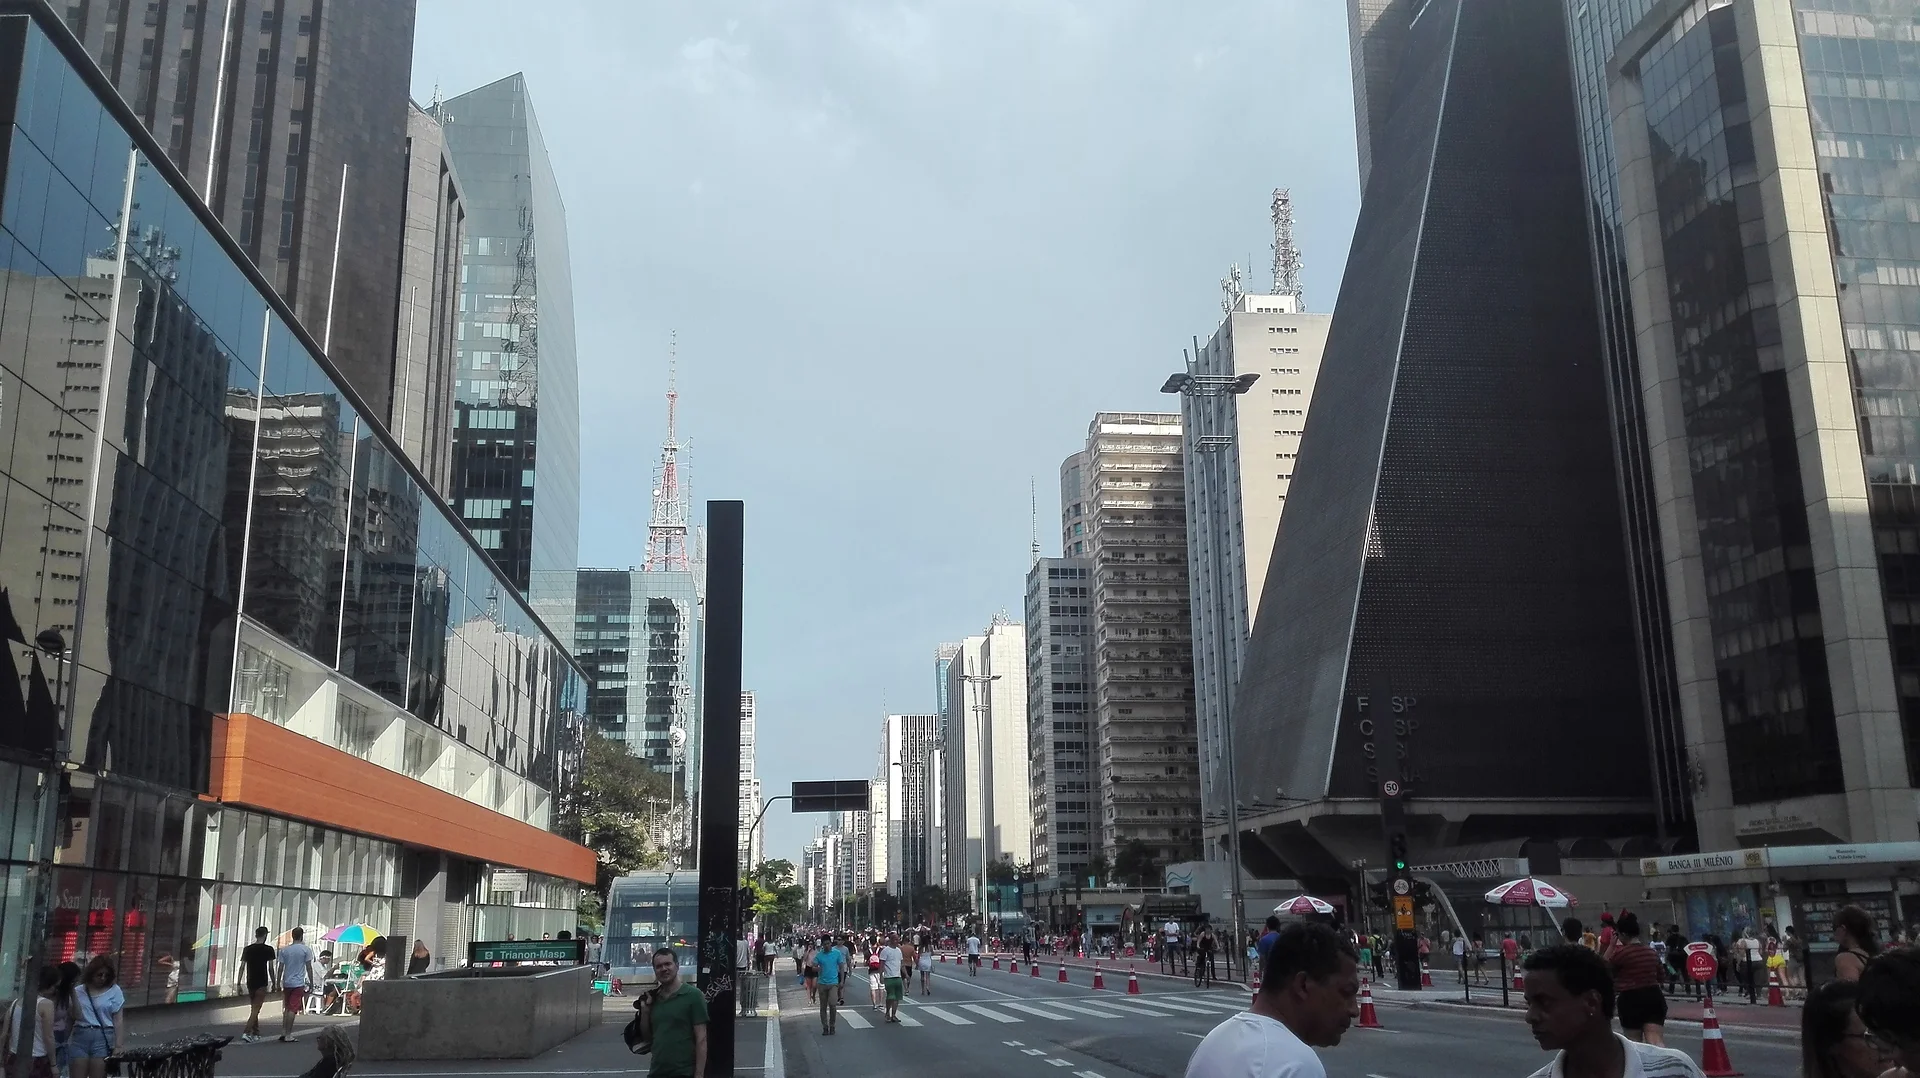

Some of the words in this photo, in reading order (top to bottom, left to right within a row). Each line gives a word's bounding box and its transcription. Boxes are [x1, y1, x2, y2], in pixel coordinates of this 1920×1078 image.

[1357, 696, 1416, 713] FSP
[1360, 719, 1419, 735] CSP
[1364, 742, 1409, 759] SSI
[1386, 783, 1397, 791] 50
[1668, 859, 1691, 870] BANCA
[1693, 858, 1701, 868] III
[500, 950, 566, 960] Trianon-Masp
